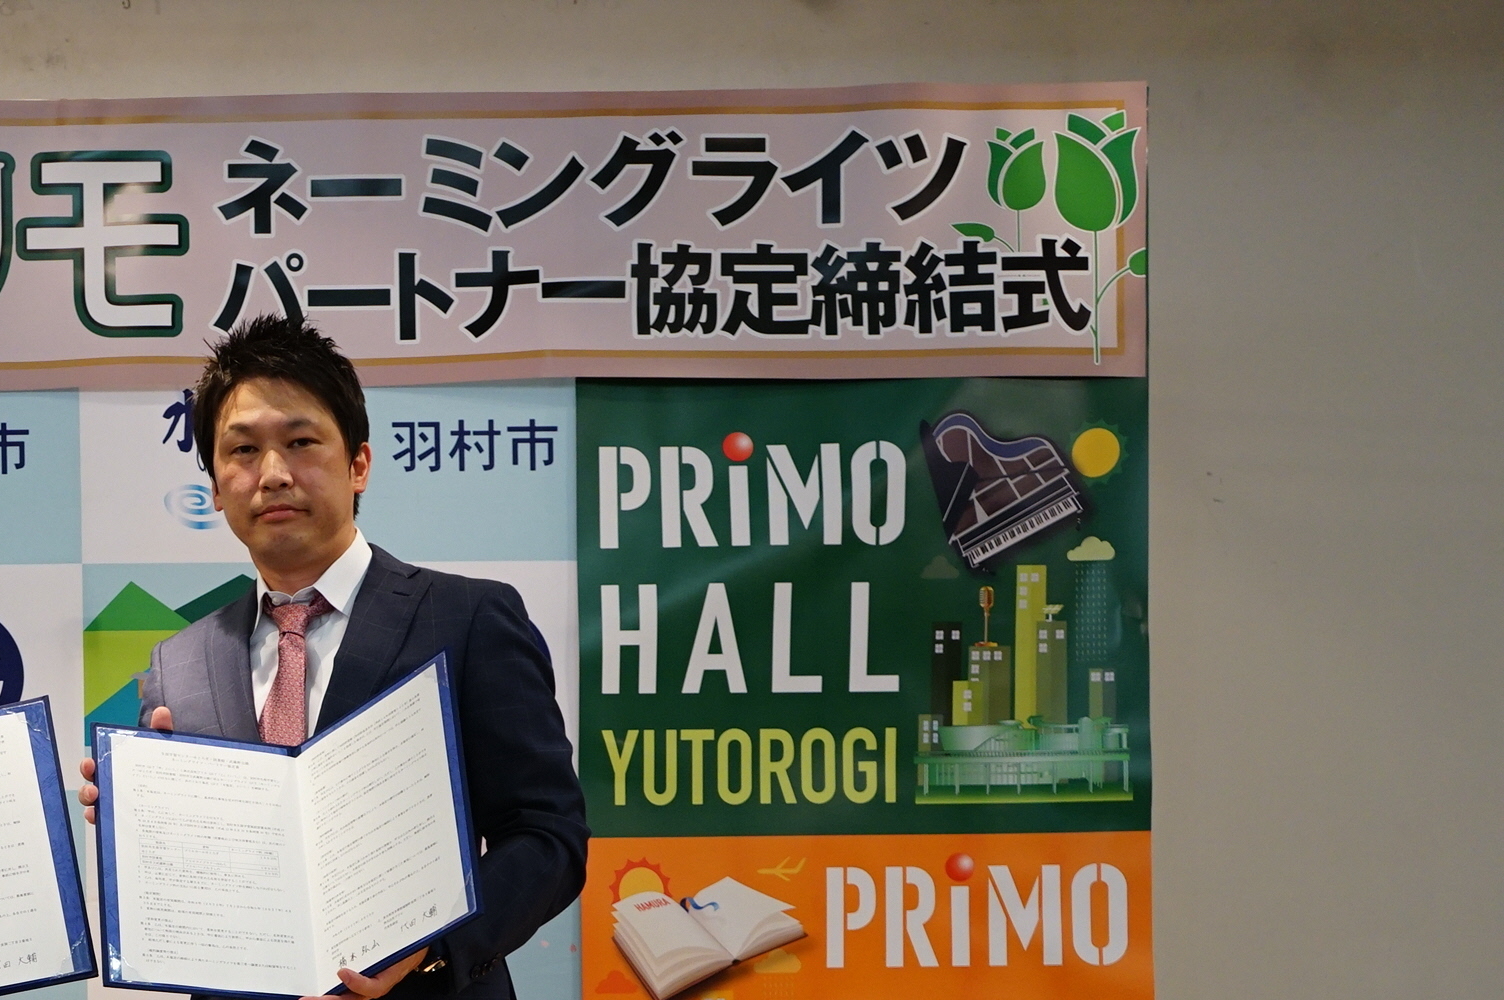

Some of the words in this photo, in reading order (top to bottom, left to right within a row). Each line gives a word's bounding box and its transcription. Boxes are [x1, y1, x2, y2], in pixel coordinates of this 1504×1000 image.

[215, 127, 969, 238] ネーミングライツ
[213, 239, 1092, 342] パートナー協定締結式
[391, 418, 558, 473] 羽村市
[600, 581, 900, 694] HALL
[601, 726, 898, 807] YUTOROGI
[633, 897, 671, 912] HAMURA
